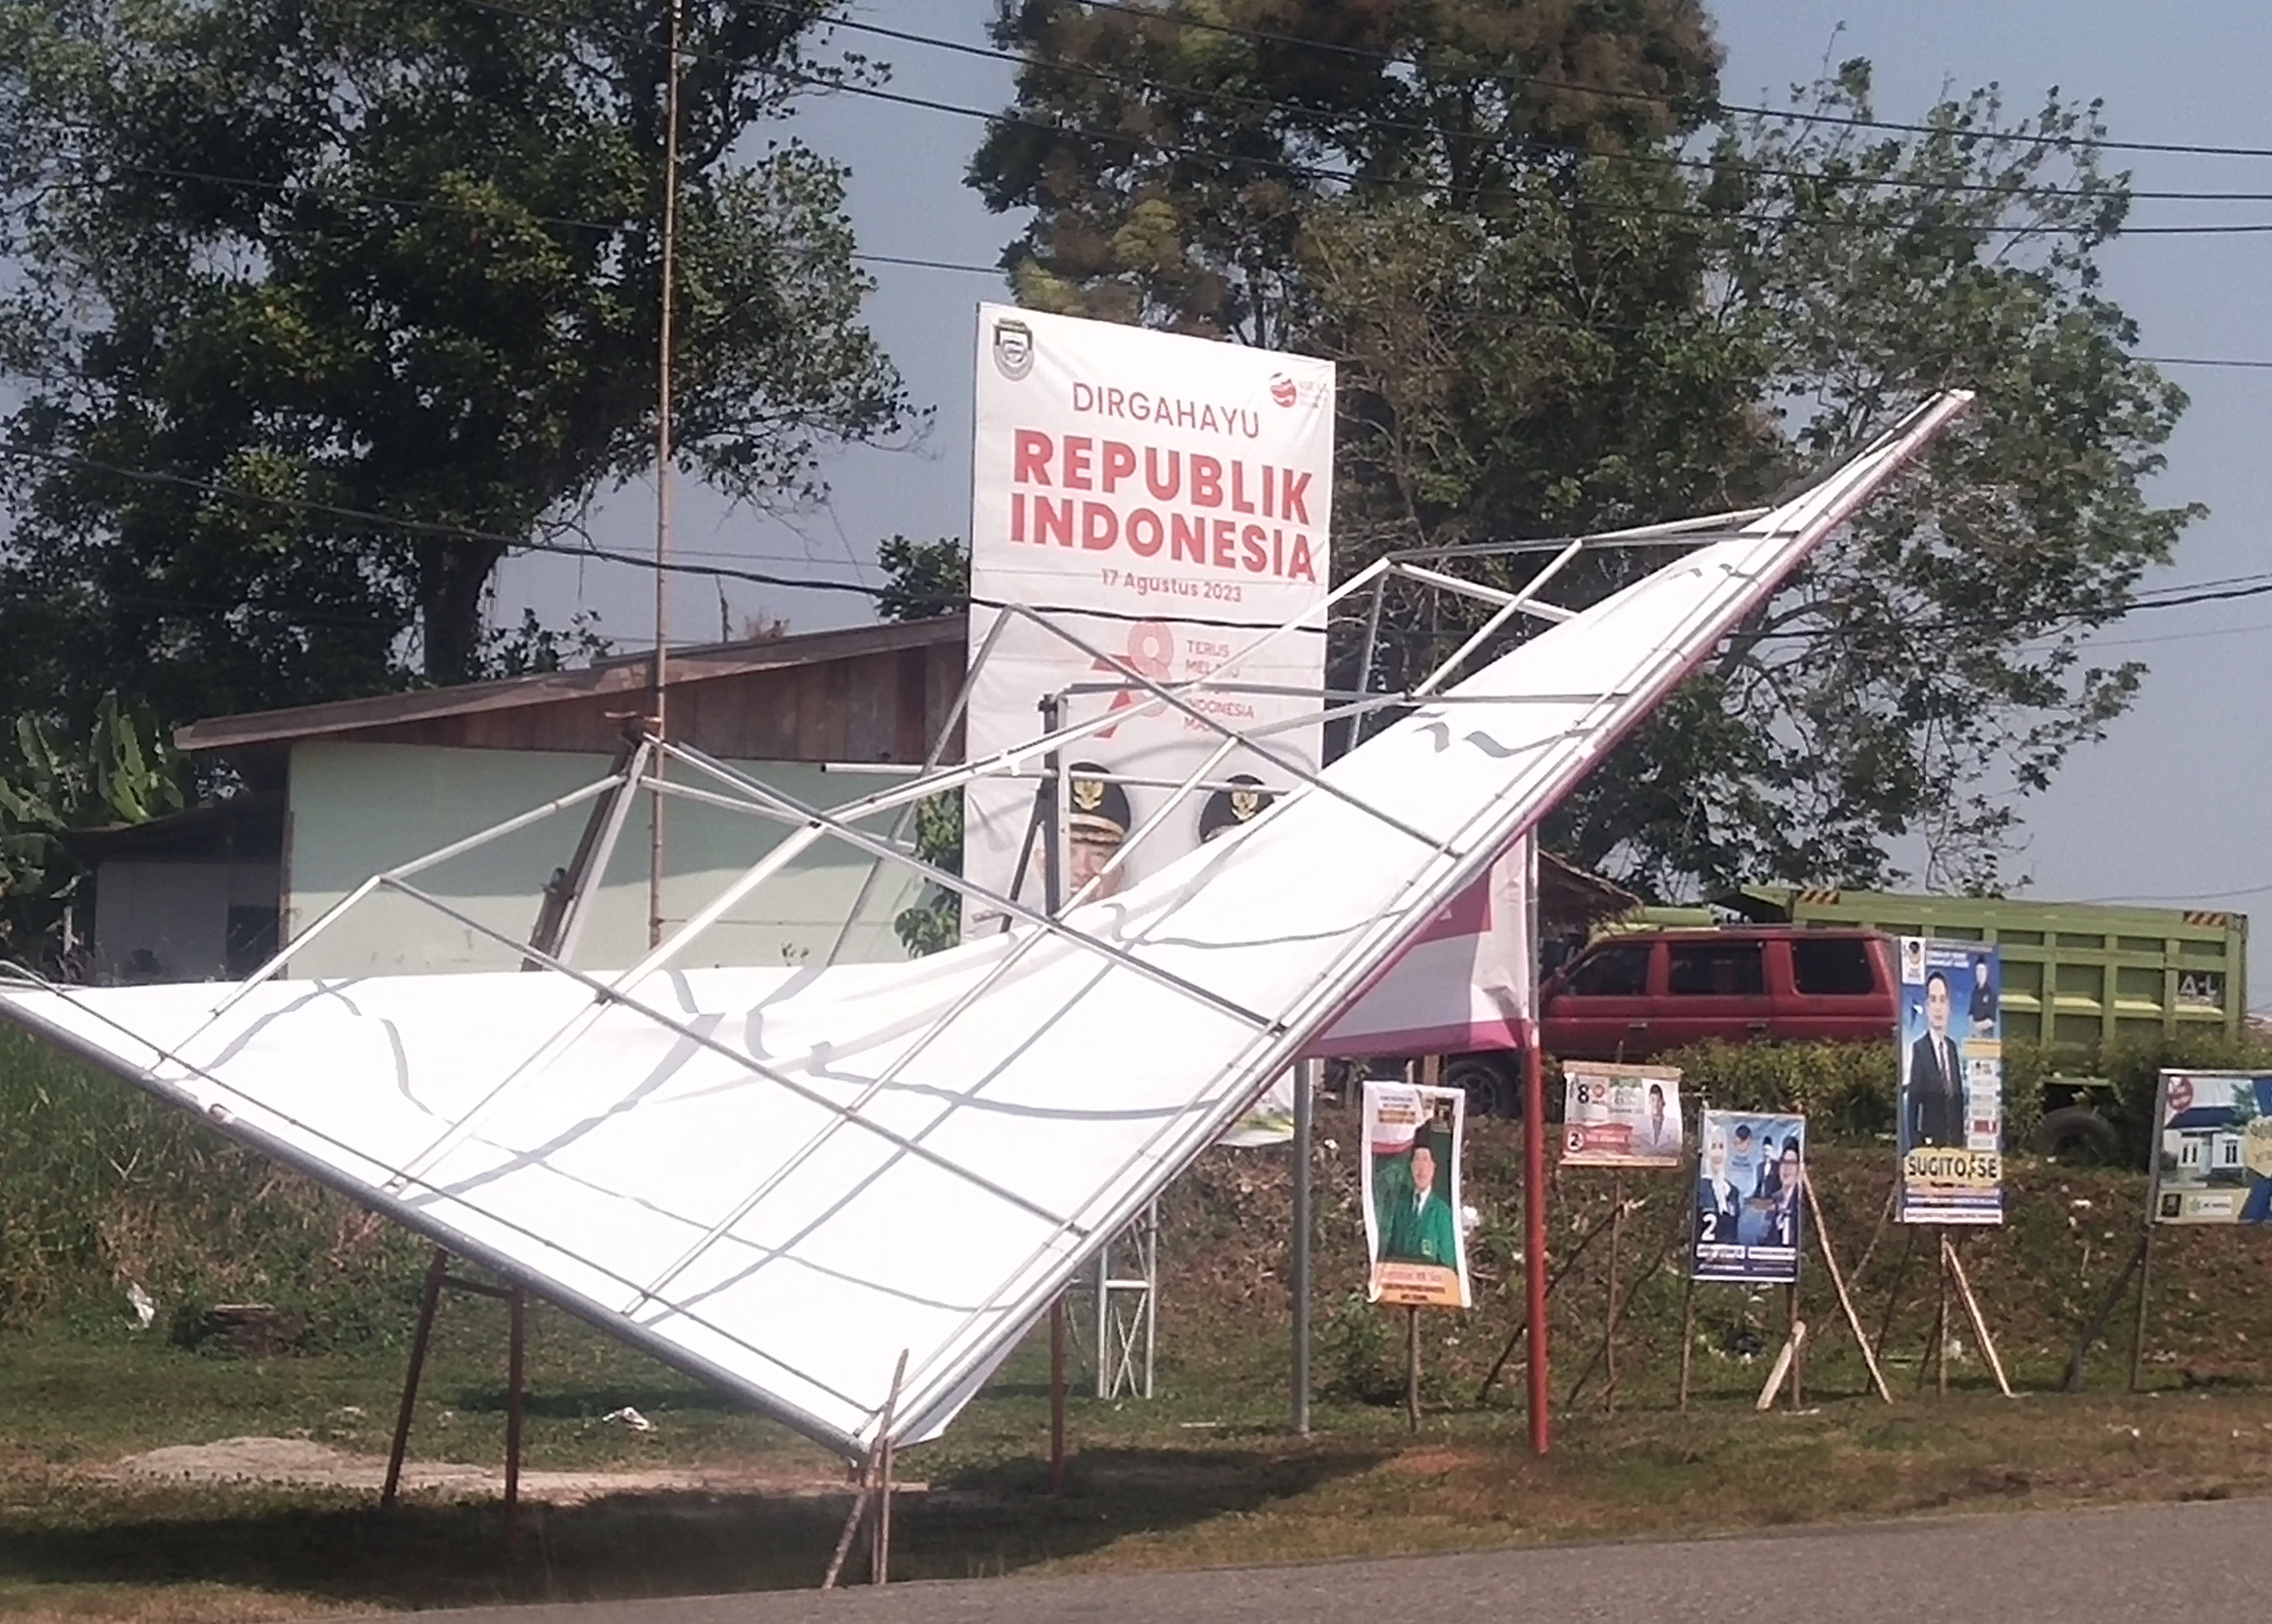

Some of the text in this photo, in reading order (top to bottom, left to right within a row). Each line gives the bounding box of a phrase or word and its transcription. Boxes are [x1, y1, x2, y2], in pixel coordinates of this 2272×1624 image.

[1072, 381, 1259, 440] DIRGAHAYU
[1014, 428, 1313, 526] REPUBLIK
[1010, 492, 1317, 584] INDONESIA
[1101, 568, 1242, 603] 17 Agustus 2023
[1187, 640, 1230, 658] TERUS
[1570, 1132, 1580, 1147] 2
[1701, 1213, 1717, 1241] 2
